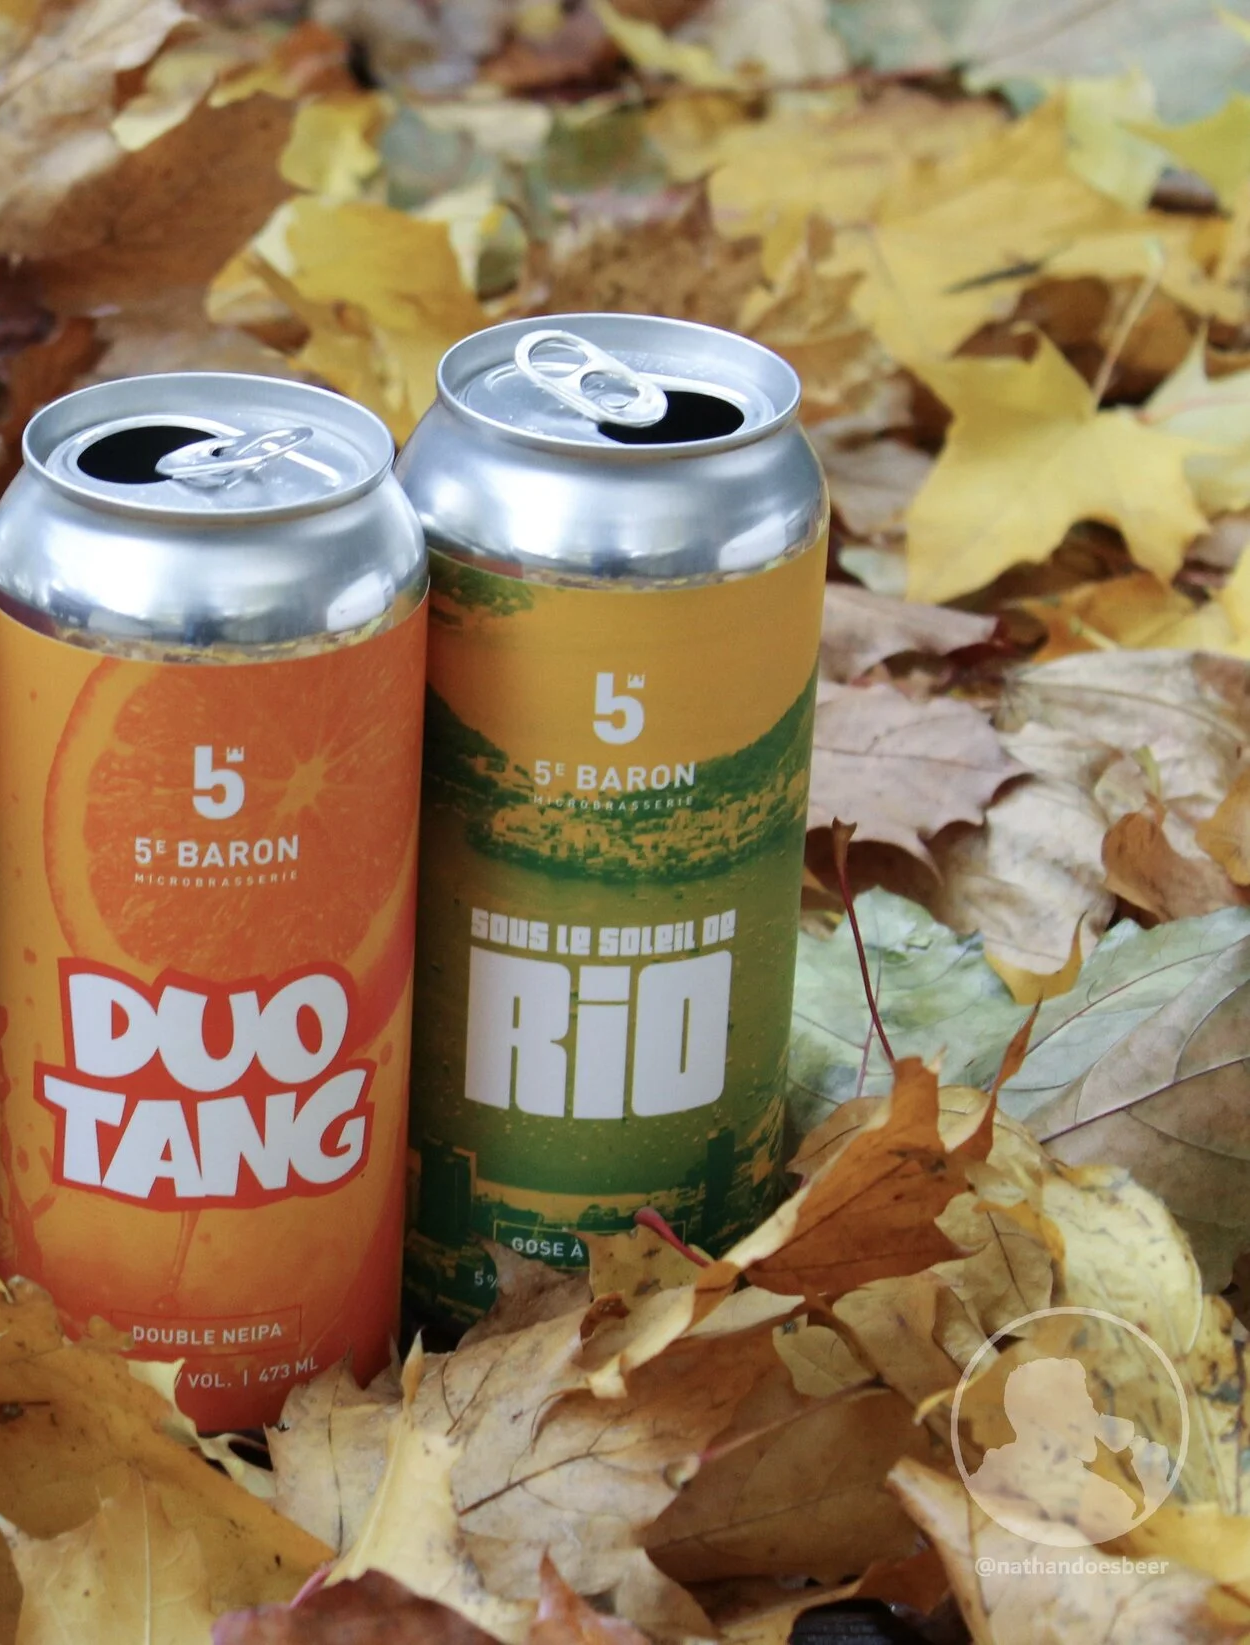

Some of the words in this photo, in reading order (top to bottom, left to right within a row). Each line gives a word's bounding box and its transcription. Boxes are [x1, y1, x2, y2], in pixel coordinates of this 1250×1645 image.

[576, 761, 696, 792] BARON
[534, 795, 694, 812] MICROBRASSERIE
[177, 835, 299, 868] BARON
[134, 869, 299, 888] MICROBRASSERIE
[470, 907, 549, 952] SOUS
[67, 972, 350, 1093] DUO
[42, 1068, 368, 1199] TANG
[511, 1236, 564, 1258] GOSE
[132, 1325, 216, 1346] DOUBLE
[222, 1322, 283, 1344] NEIPA
[188, 1373, 232, 1389] VOL.
[259, 1364, 290, 1383] 473
[295, 1356, 318, 1375] ML
